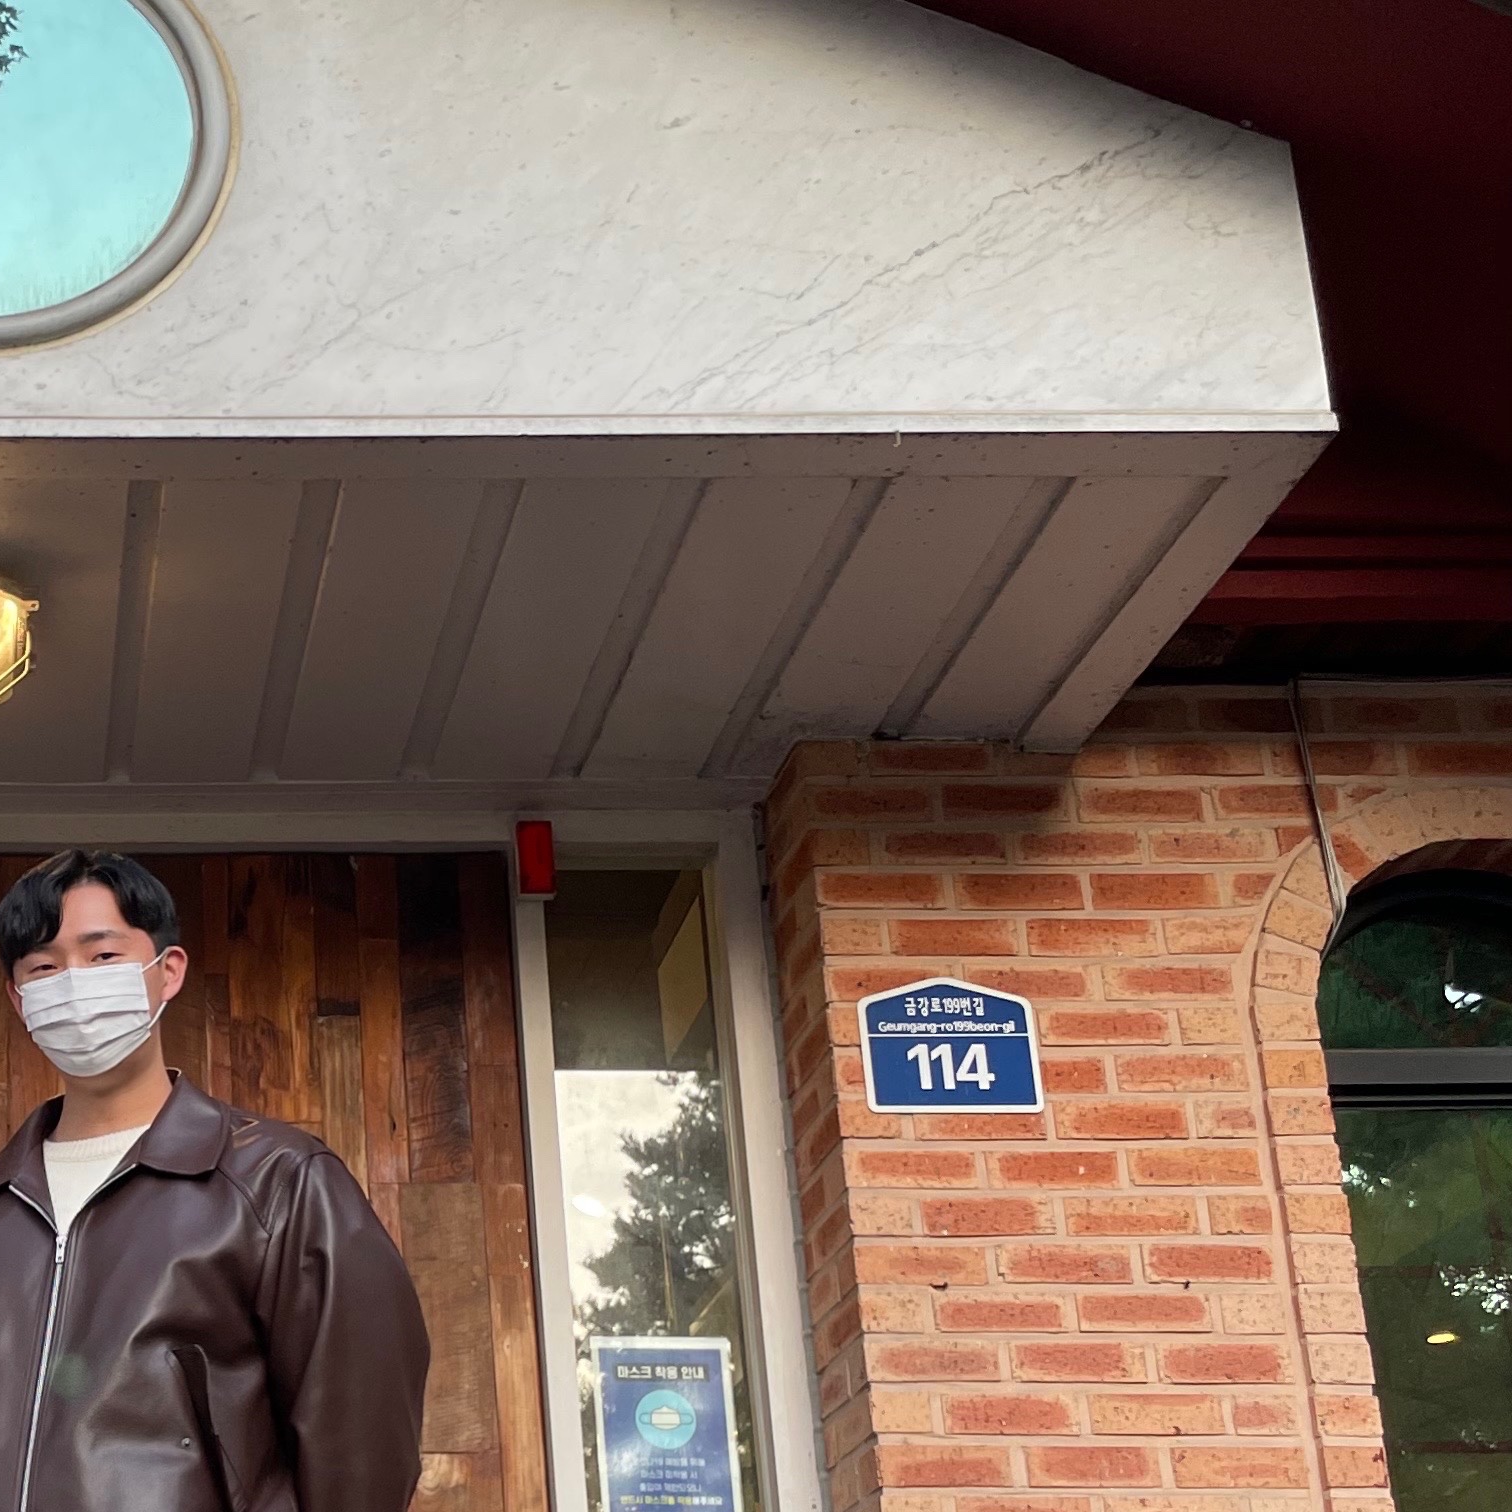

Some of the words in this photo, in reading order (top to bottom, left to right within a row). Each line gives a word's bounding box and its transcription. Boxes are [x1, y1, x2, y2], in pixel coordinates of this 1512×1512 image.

[904, 997, 985, 1017] 금강로199번길
[907, 1043, 996, 1091] 114
[617, 1365, 652, 1379] 마스크
[655, 1365, 678, 1380] 착용
[680, 1366, 705, 1380] 안내
